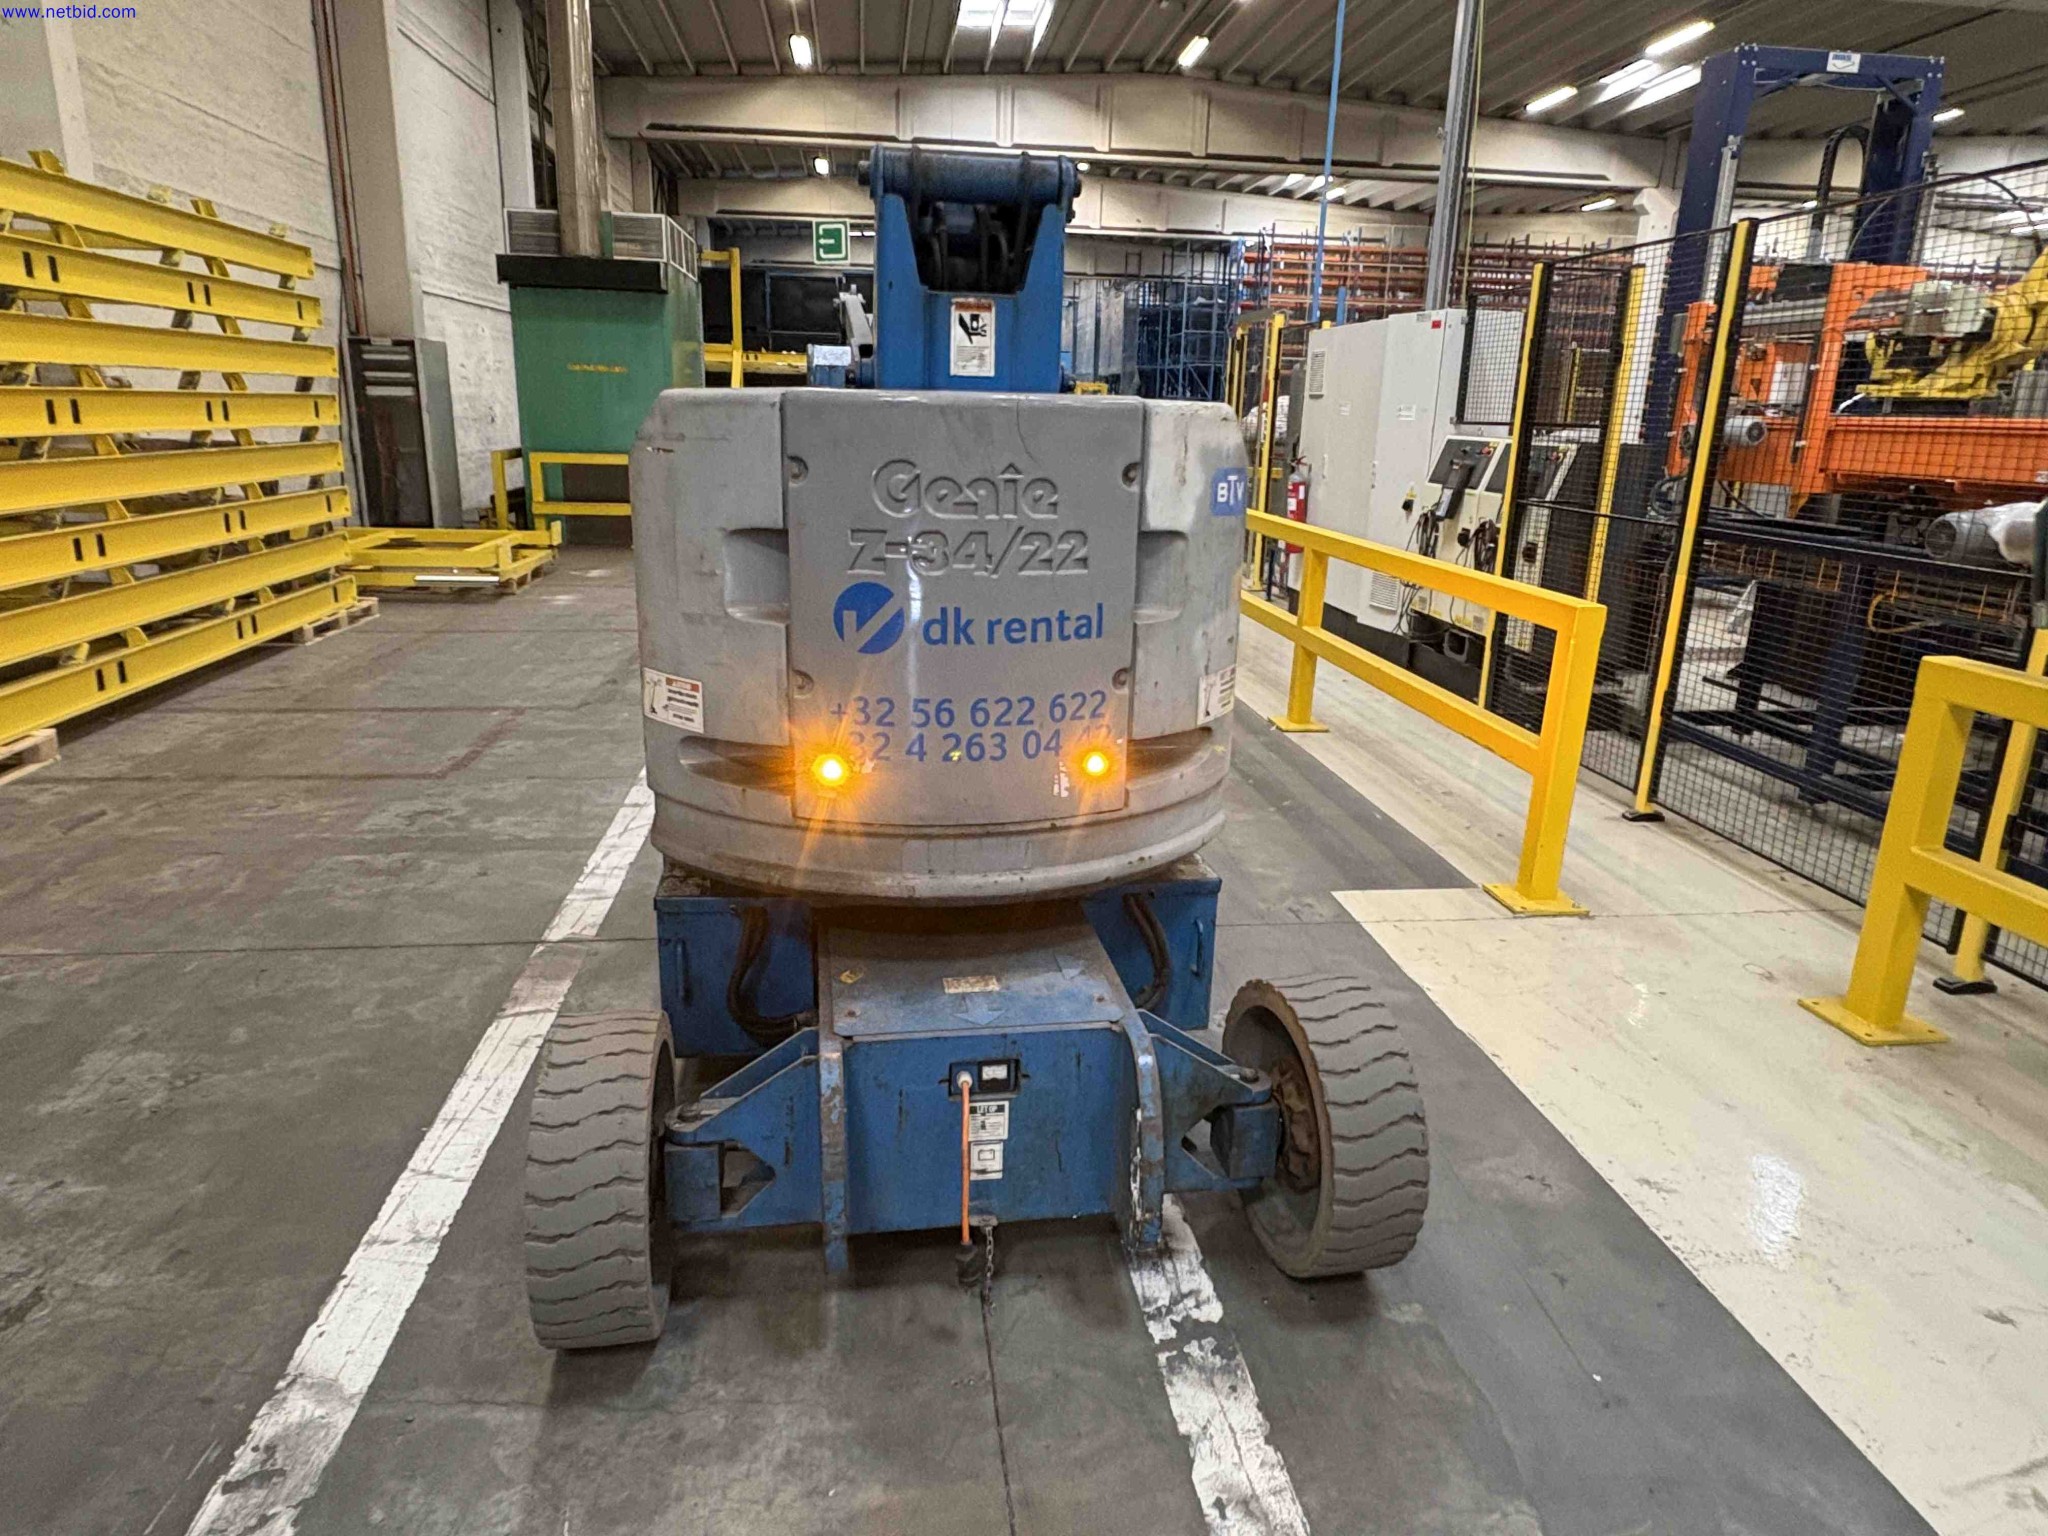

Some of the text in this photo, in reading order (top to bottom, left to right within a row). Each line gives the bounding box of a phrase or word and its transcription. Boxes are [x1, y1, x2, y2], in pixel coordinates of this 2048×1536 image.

[848, 526, 1088, 578] Z-34/22
[922, 603, 1104, 645] dk rental
[830, 690, 1106, 728] +32 56 622 622
[905, 732, 927, 762] 4
[942, 732, 1007, 762] 263
[1023, 728, 1062, 760] 04
